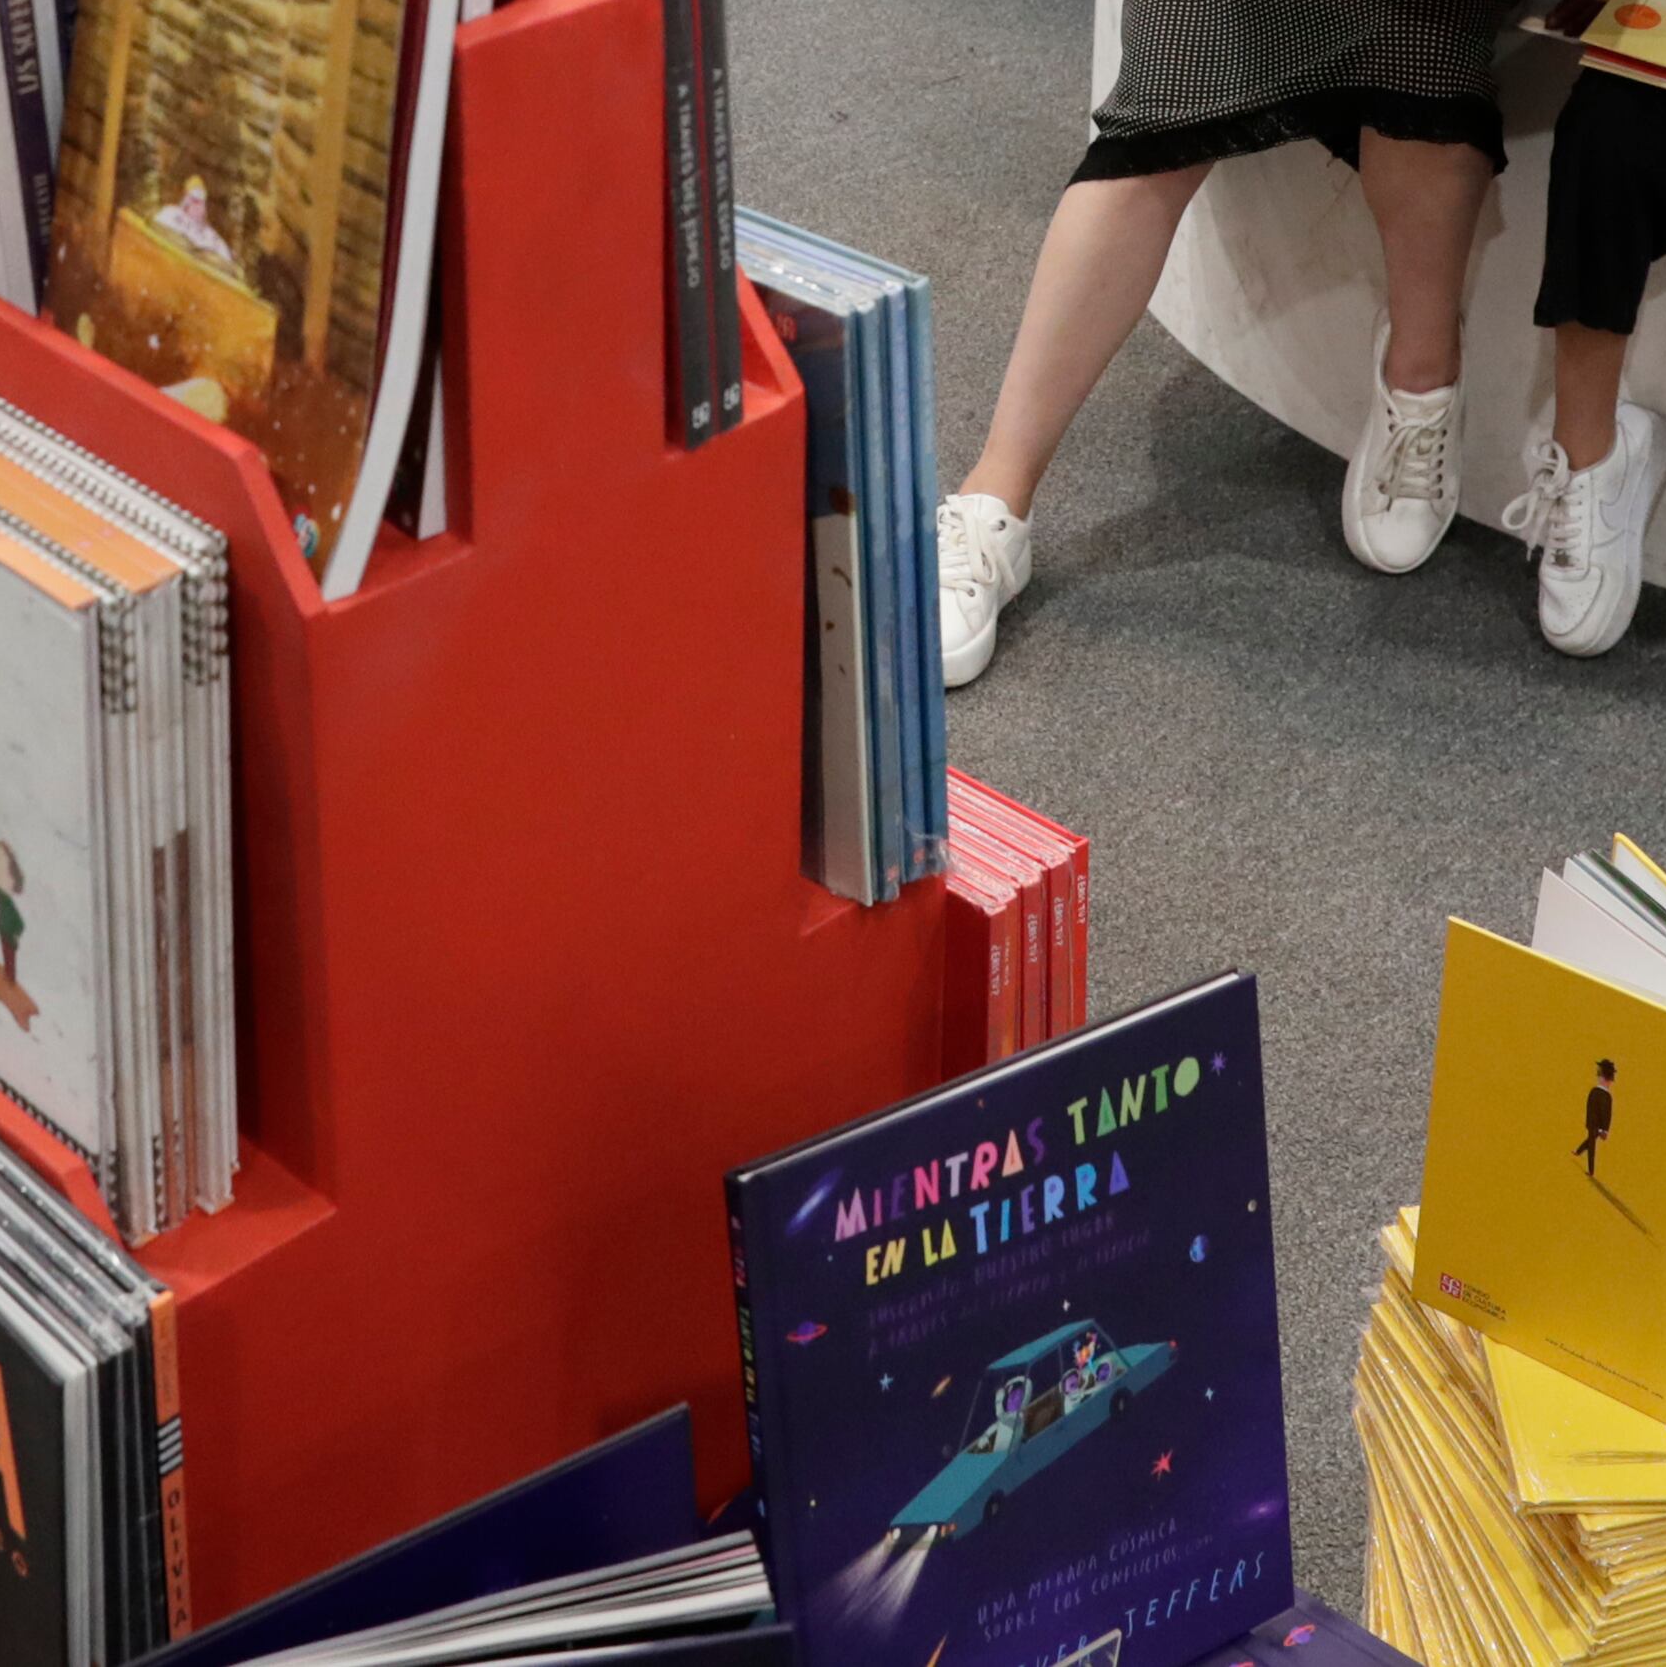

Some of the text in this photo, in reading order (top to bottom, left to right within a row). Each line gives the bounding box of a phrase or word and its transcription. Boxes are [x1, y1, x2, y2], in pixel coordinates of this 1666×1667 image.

[834, 1054, 1201, 1243] MIENTRAS TANTO
[864, 1149, 1131, 1286] EN LA TIERRA
[165, 1490, 190, 1632] OLIVIA
[976, 1515, 1178, 1626] UNA MIRADA CÓSMICA
[1123, 1550, 1265, 1639] JEFFERS
